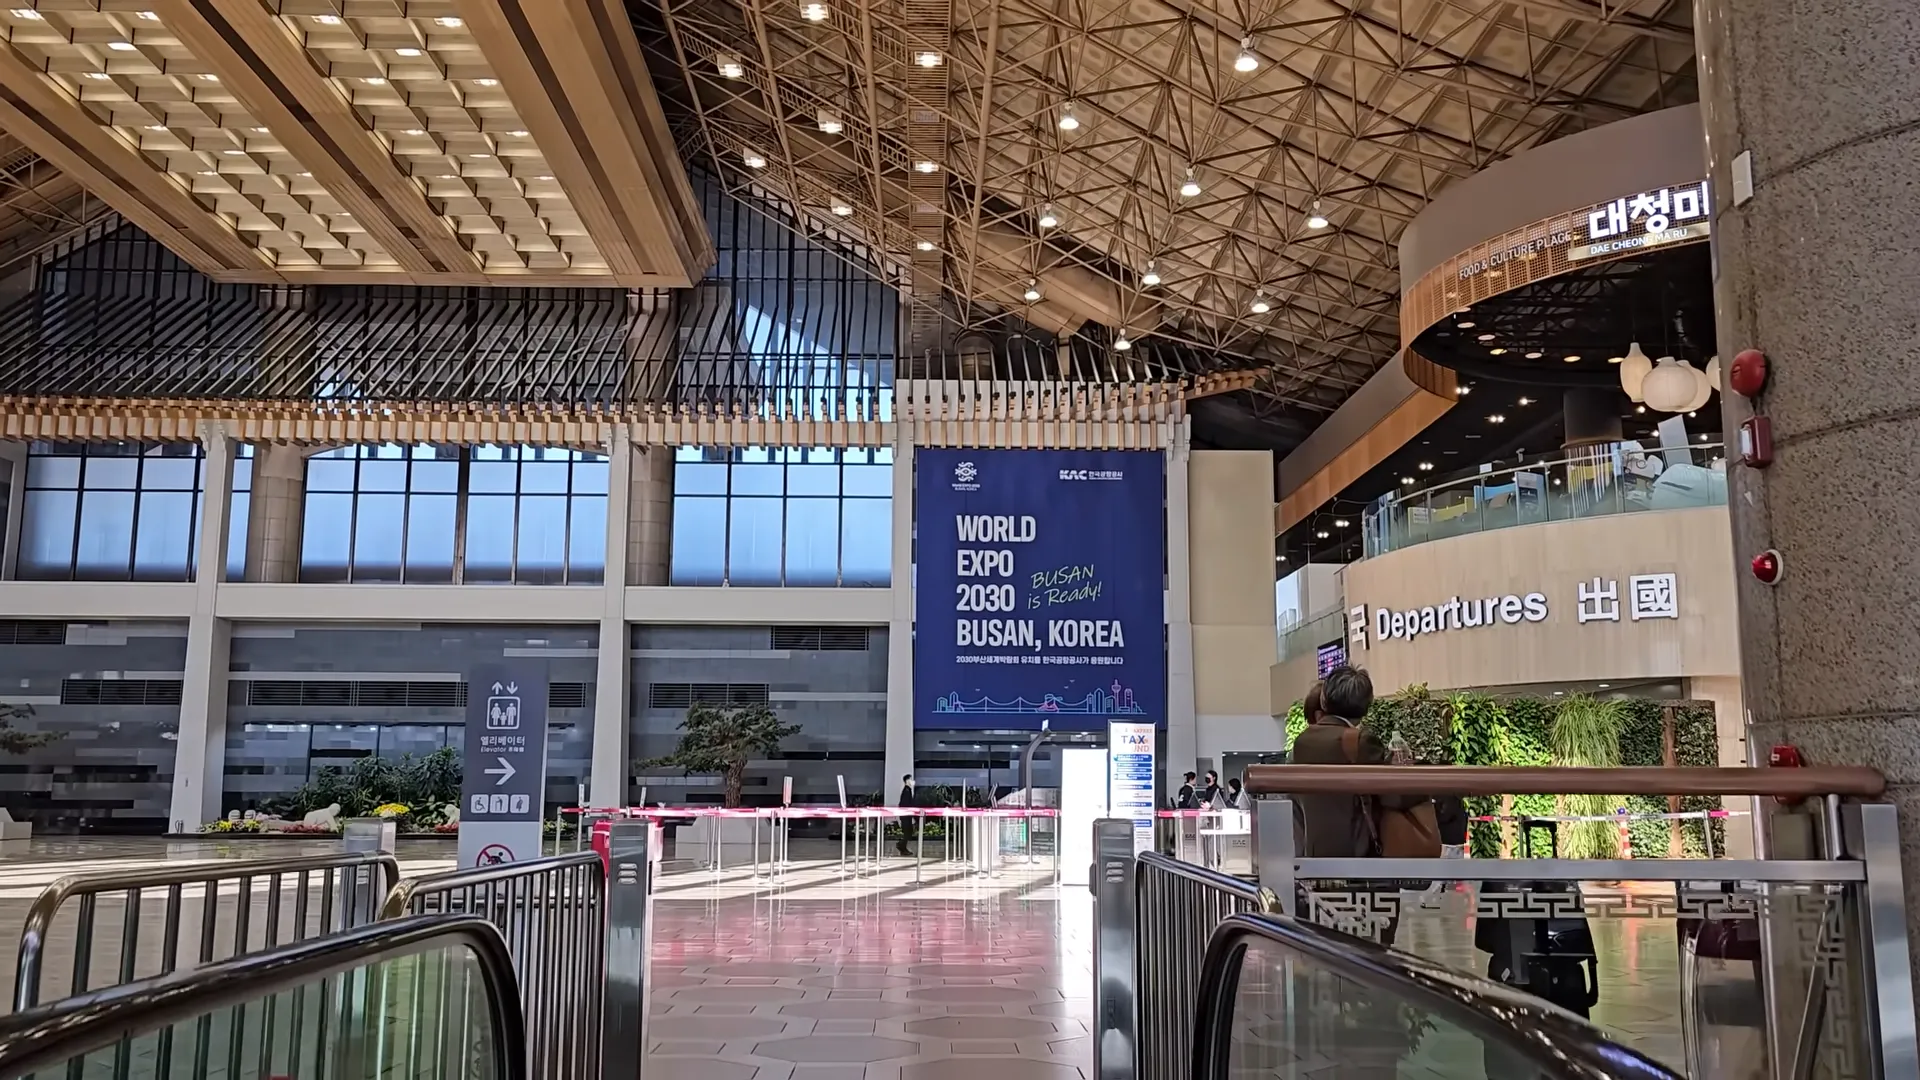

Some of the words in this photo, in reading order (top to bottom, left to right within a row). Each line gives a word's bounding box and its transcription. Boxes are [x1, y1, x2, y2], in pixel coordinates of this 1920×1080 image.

[1590, 244, 1610, 255] DAE
[1655, 231, 1671, 243] MA
[1673, 228, 1688, 238] RU
[1459, 262, 1480, 280] FOOD
[1481, 259, 1488, 270] &
[1490, 242, 1535, 266] CULTURE
[1059, 469, 1087, 480] KAC
[956, 514, 1036, 542] WORLD
[957, 550, 1014, 577] EXPO
[1030, 564, 1094, 589] BUSAN
[956, 584, 1016, 612] 2030
[1027, 593, 1041, 610] is
[1043, 581, 1102, 607] Ready!
[1376, 591, 1548, 642] Departures
[956, 619, 1042, 652] BUSAN,
[1048, 620, 1125, 648] KOREA
[480, 735, 526, 746] 엘리베이터
[1121, 735, 1146, 744] TAX
